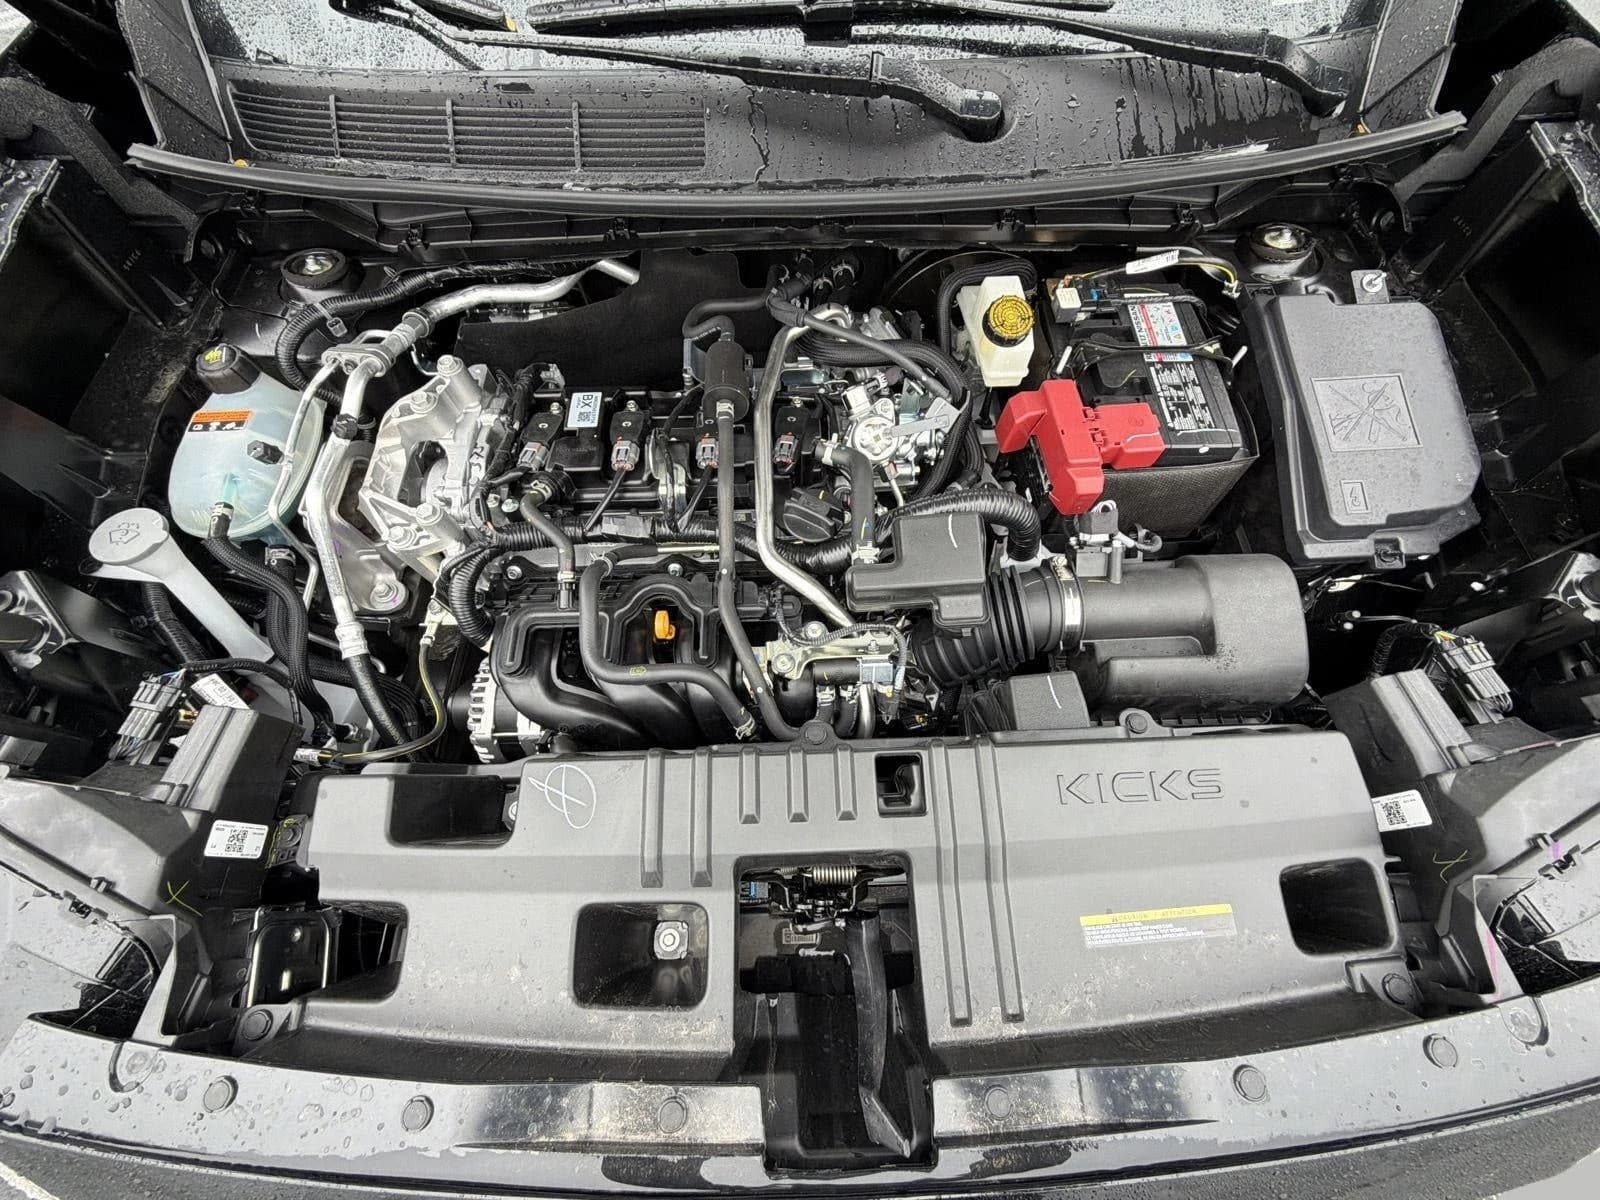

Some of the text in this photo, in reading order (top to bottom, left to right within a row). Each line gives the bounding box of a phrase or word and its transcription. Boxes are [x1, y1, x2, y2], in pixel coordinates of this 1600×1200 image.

[1130, 303, 1143, 333] NISSAN
[580, 394, 594, 409] BX
[1056, 768, 1224, 805] KICKS
